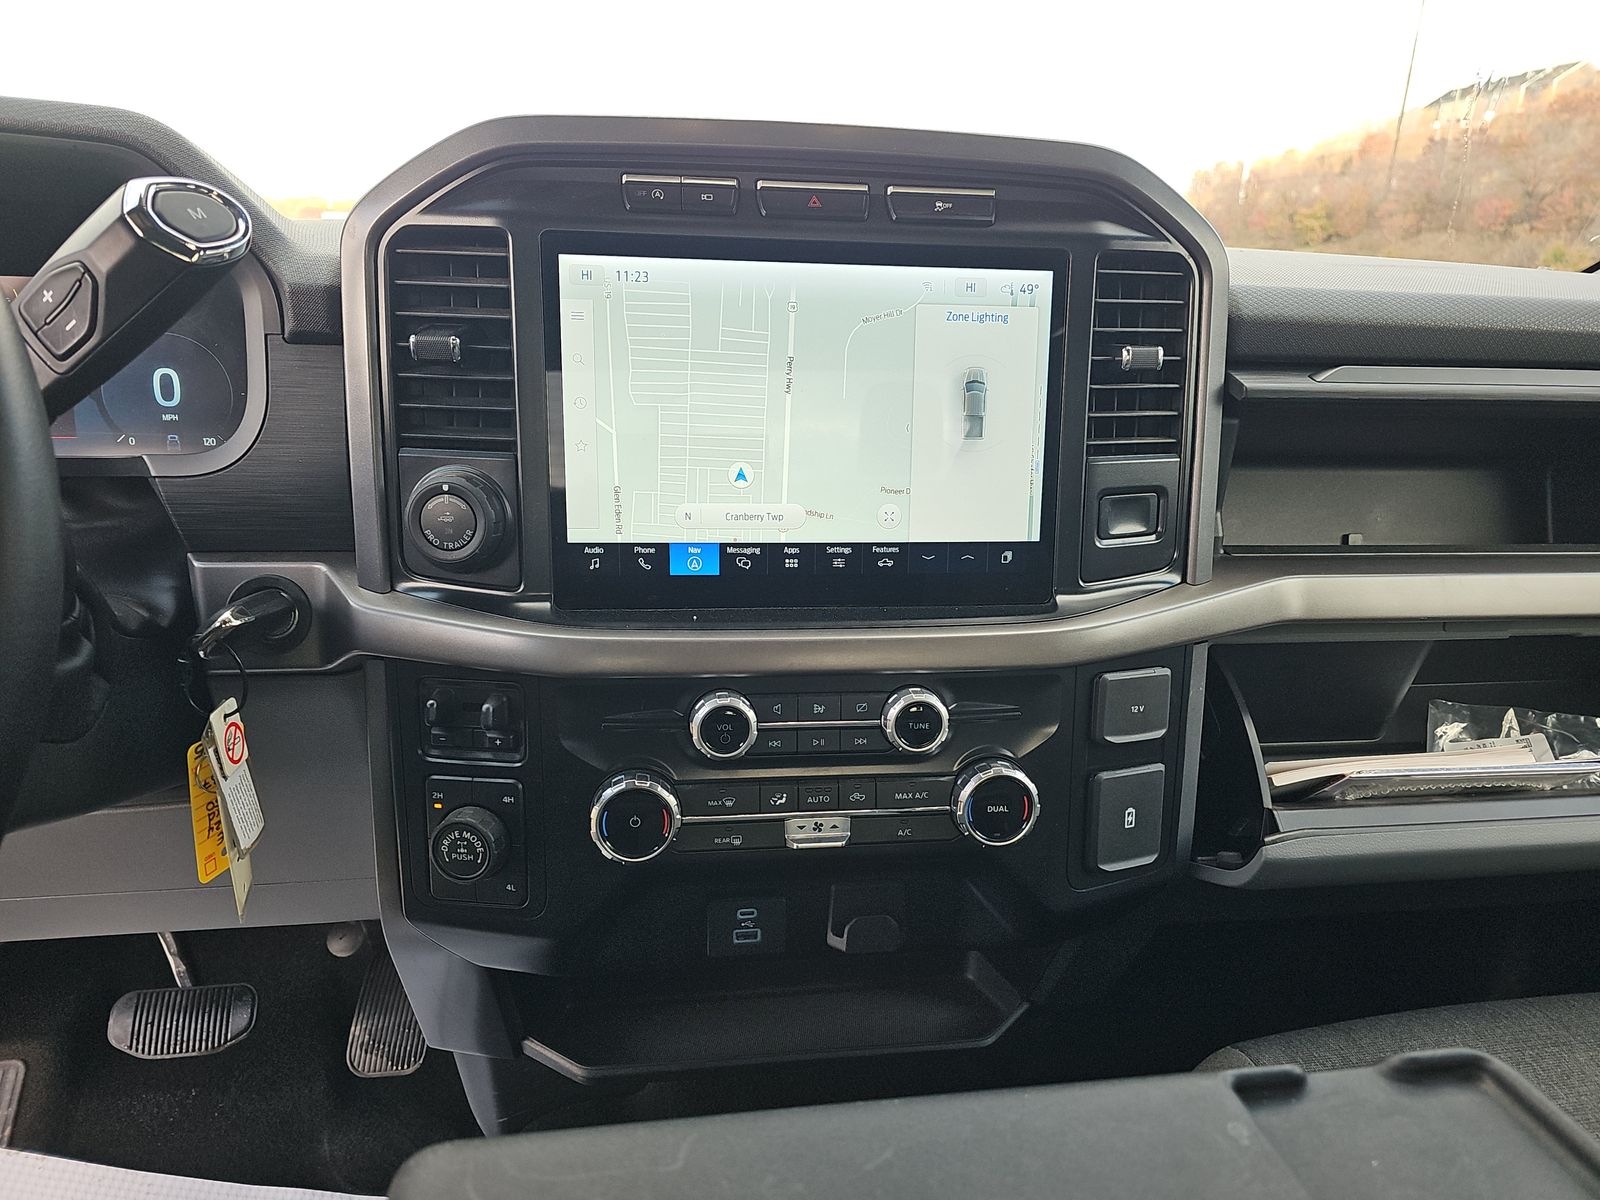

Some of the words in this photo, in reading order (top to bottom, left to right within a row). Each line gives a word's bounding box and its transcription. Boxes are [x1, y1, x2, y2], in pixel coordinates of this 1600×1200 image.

[187, 208, 207, 219] M
[581, 269, 593, 281] HI
[615, 270, 650, 283] 11:23
[965, 282, 977, 293] HI
[1019, 283, 1040, 295] 49°
[895, 308, 903, 317] Dr
[946, 311, 970, 323] Zone
[971, 312, 1009, 325] Lighting
[784, 356, 795, 376] Perry
[153, 367, 181, 407] 0
[784, 377, 793, 395] Hwy
[162, 413, 179, 422] MPH
[128, 437, 136, 446] 0
[202, 437, 217, 446] 120
[613, 485, 622, 503] Glen
[880, 486, 904, 496] Pioneer
[614, 504, 622, 523] Eden
[684, 512, 692, 520] N
[725, 512, 765, 523] Cranberry
[766, 512, 784, 523] Twp
[615, 525, 624, 535] Rd
[423, 529, 440, 546] PRO
[443, 529, 475, 550] TRAILER
[584, 545, 604, 554] Audio
[634, 545, 656, 554] Phone
[688, 546, 702, 554] Nav
[726, 545, 761, 555] Messaging
[783, 546, 800, 555] Apps
[826, 546, 852, 555] Settings
[872, 545, 900, 554] Features
[1130, 705, 1139, 713] 12
[716, 723, 734, 731] VOL
[908, 721, 930, 730] TUNE
[431, 791, 444, 799] 2H
[807, 795, 830, 804] AUTO
[894, 792, 914, 801] MAX
[914, 791, 929, 800] A/C
[502, 796, 515, 804] 4H
[707, 799, 723, 807] MAX
[987, 805, 1009, 813] DUAL
[897, 828, 912, 836] A/C
[441, 830, 461, 852] DRIVE
[462, 830, 485, 853] MODE
[714, 837, 731, 845] REAR
[451, 853, 474, 861] PUSH
[505, 884, 516, 892] 4L
